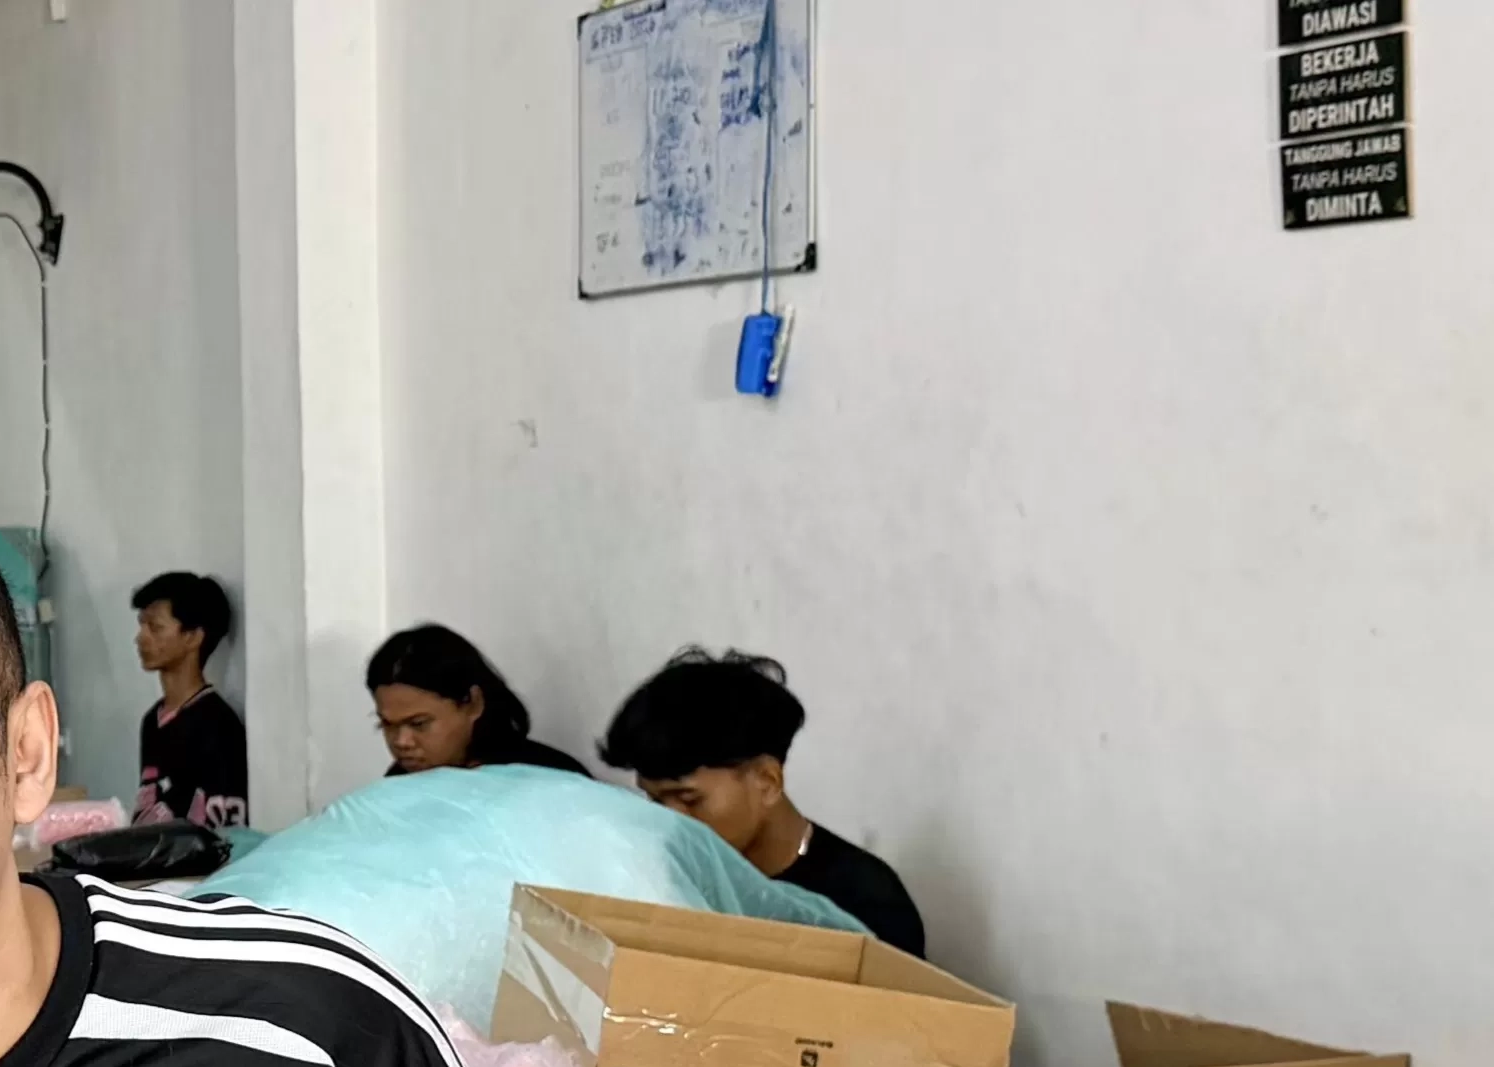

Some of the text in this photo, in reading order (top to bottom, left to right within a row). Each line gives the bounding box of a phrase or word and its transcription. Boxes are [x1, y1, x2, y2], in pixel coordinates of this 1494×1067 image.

[1302, 0, 1377, 36] DIAWASI
[1301, 41, 1379, 77] BEKERJA
[1289, 66, 1396, 102] TANPA HARUS
[1288, 93, 1394, 133] DIPERINTAH
[1284, 134, 1401, 167] TANGGUNG JAWAB
[1291, 161, 1398, 192] TANPA HARUS
[1306, 190, 1382, 221] DIMINTA
